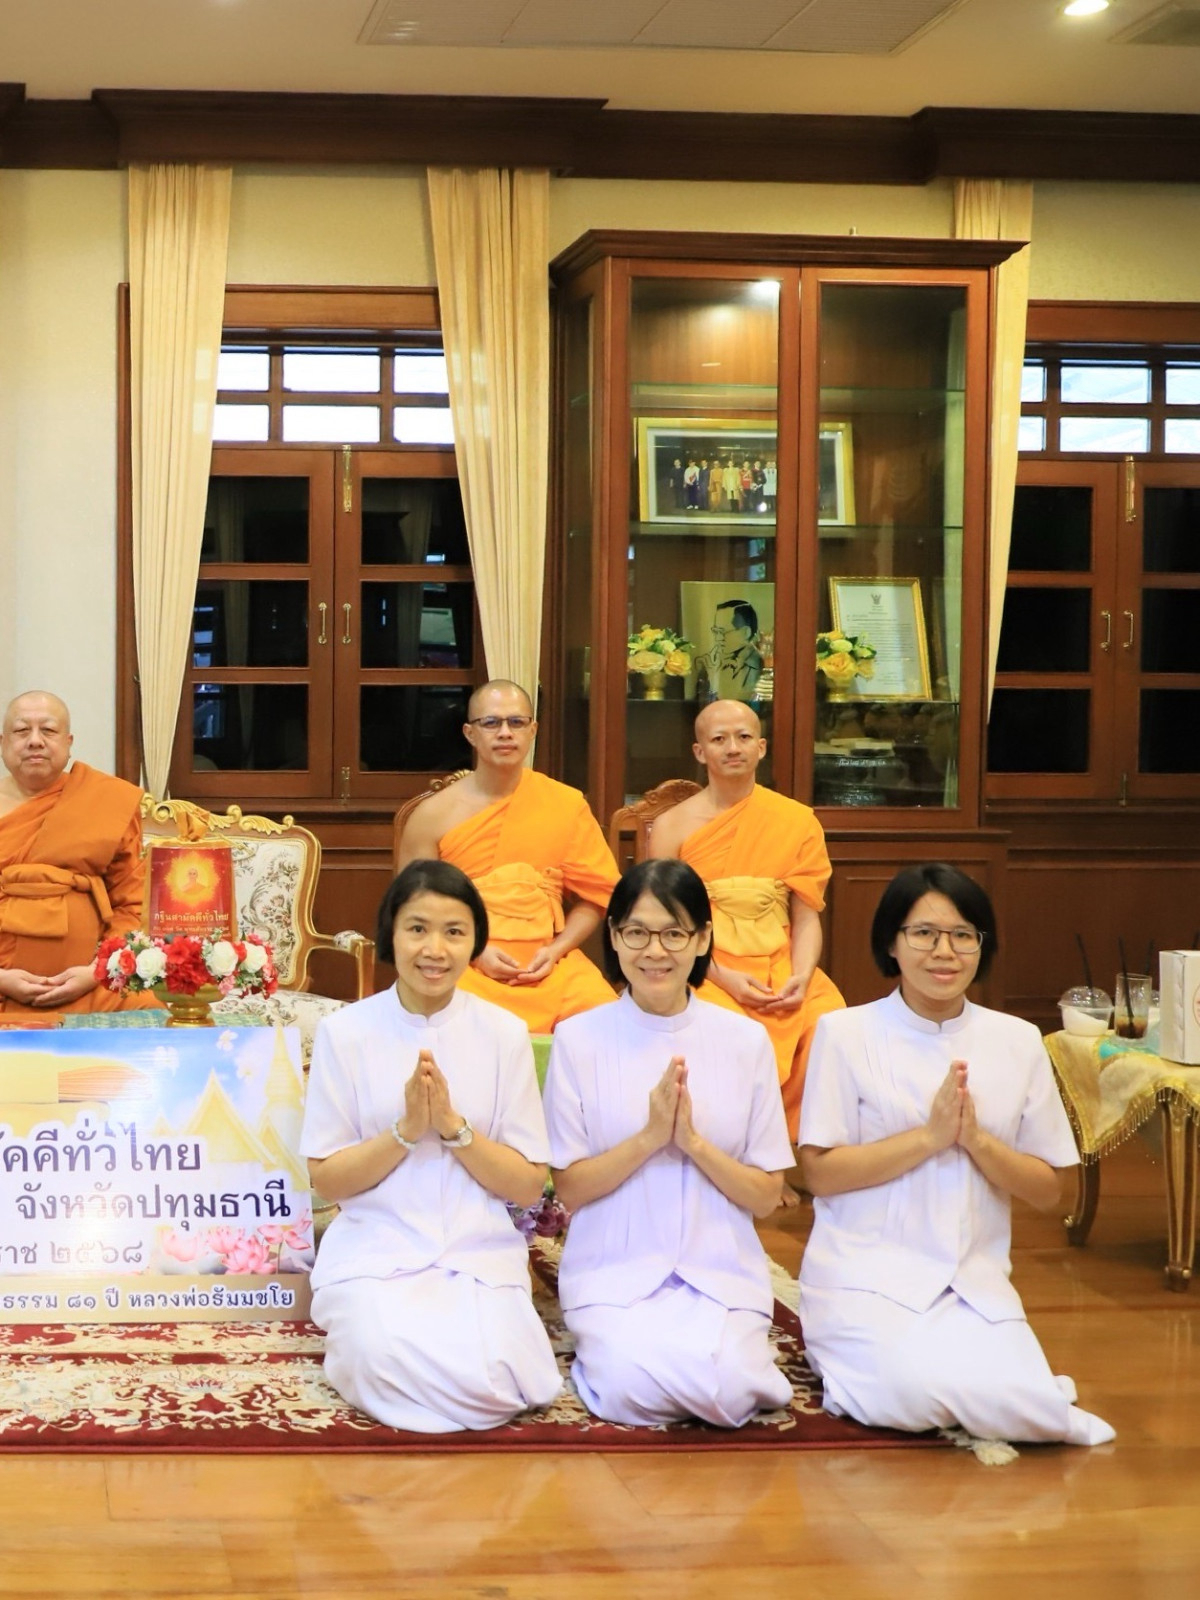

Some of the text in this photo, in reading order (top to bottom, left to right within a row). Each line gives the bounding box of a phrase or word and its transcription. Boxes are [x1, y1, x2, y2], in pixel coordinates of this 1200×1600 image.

[15, 1178, 291, 1231] จังหวัดปทุมธานี
[49, 1239, 143, 1264] ๒๕๖๘
[67, 1294, 97, 1309] ๘๑
[105, 1288, 120, 1309] ปี
[128, 1285, 293, 1308] หลวงพ่อธัมมชโย
